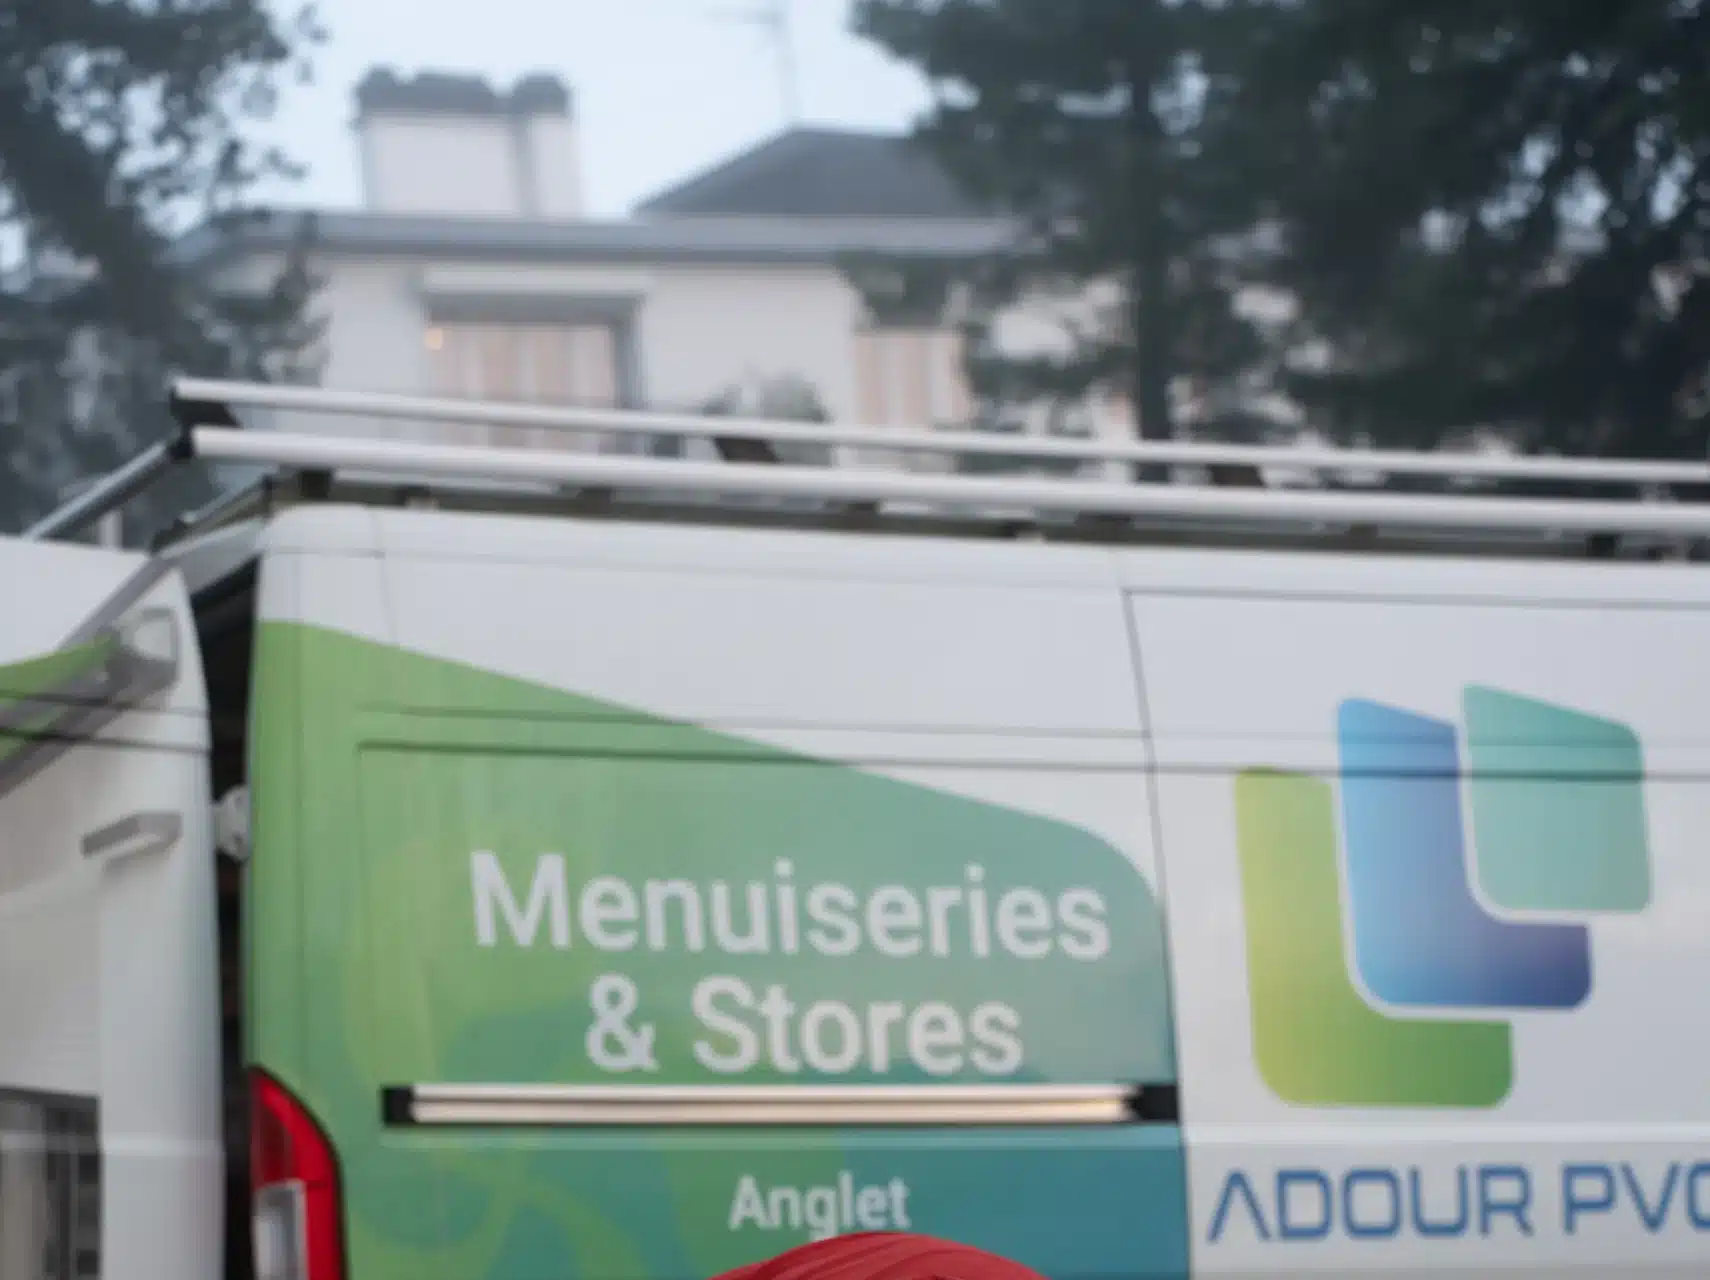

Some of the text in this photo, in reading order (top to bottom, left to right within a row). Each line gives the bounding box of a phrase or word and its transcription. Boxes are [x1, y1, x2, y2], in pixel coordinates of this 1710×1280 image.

[469, 850, 1111, 960] Menuiseries
[585, 973, 1024, 1075] & Stores
[728, 1169, 912, 1242] Anglet
[1207, 1163, 1535, 1244] ADOUR
